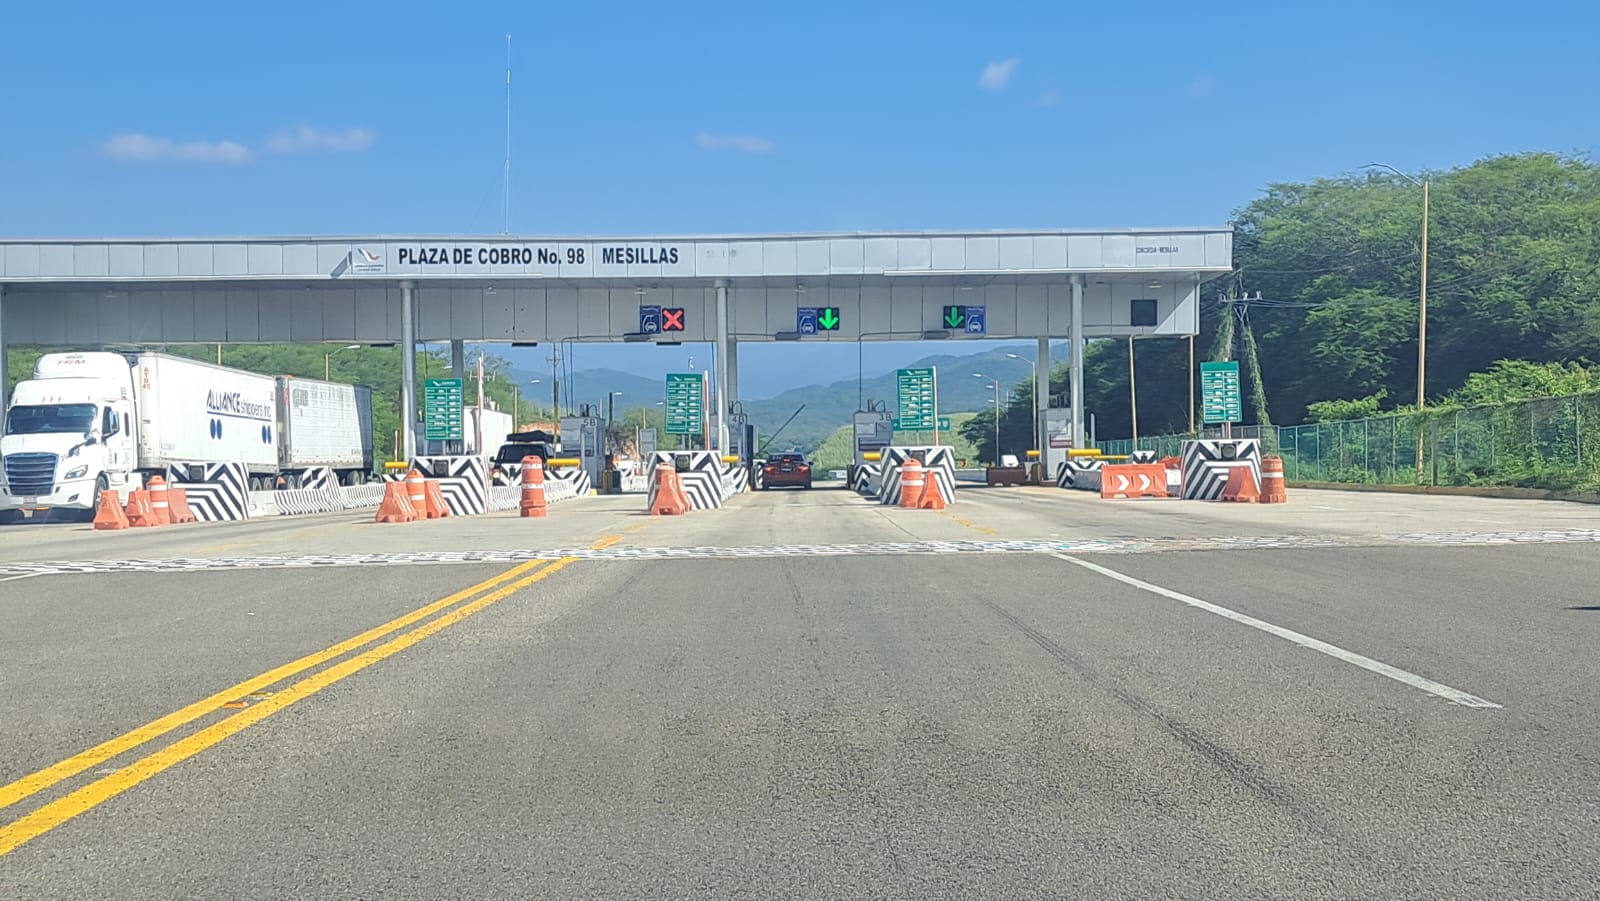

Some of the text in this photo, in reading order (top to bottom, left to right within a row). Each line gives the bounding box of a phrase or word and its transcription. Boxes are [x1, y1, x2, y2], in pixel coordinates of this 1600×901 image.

[399, 247, 679, 264] PLAZA DE COBRO No. 98 MESILLAS
[206, 388, 241, 413] ALLIANCE
